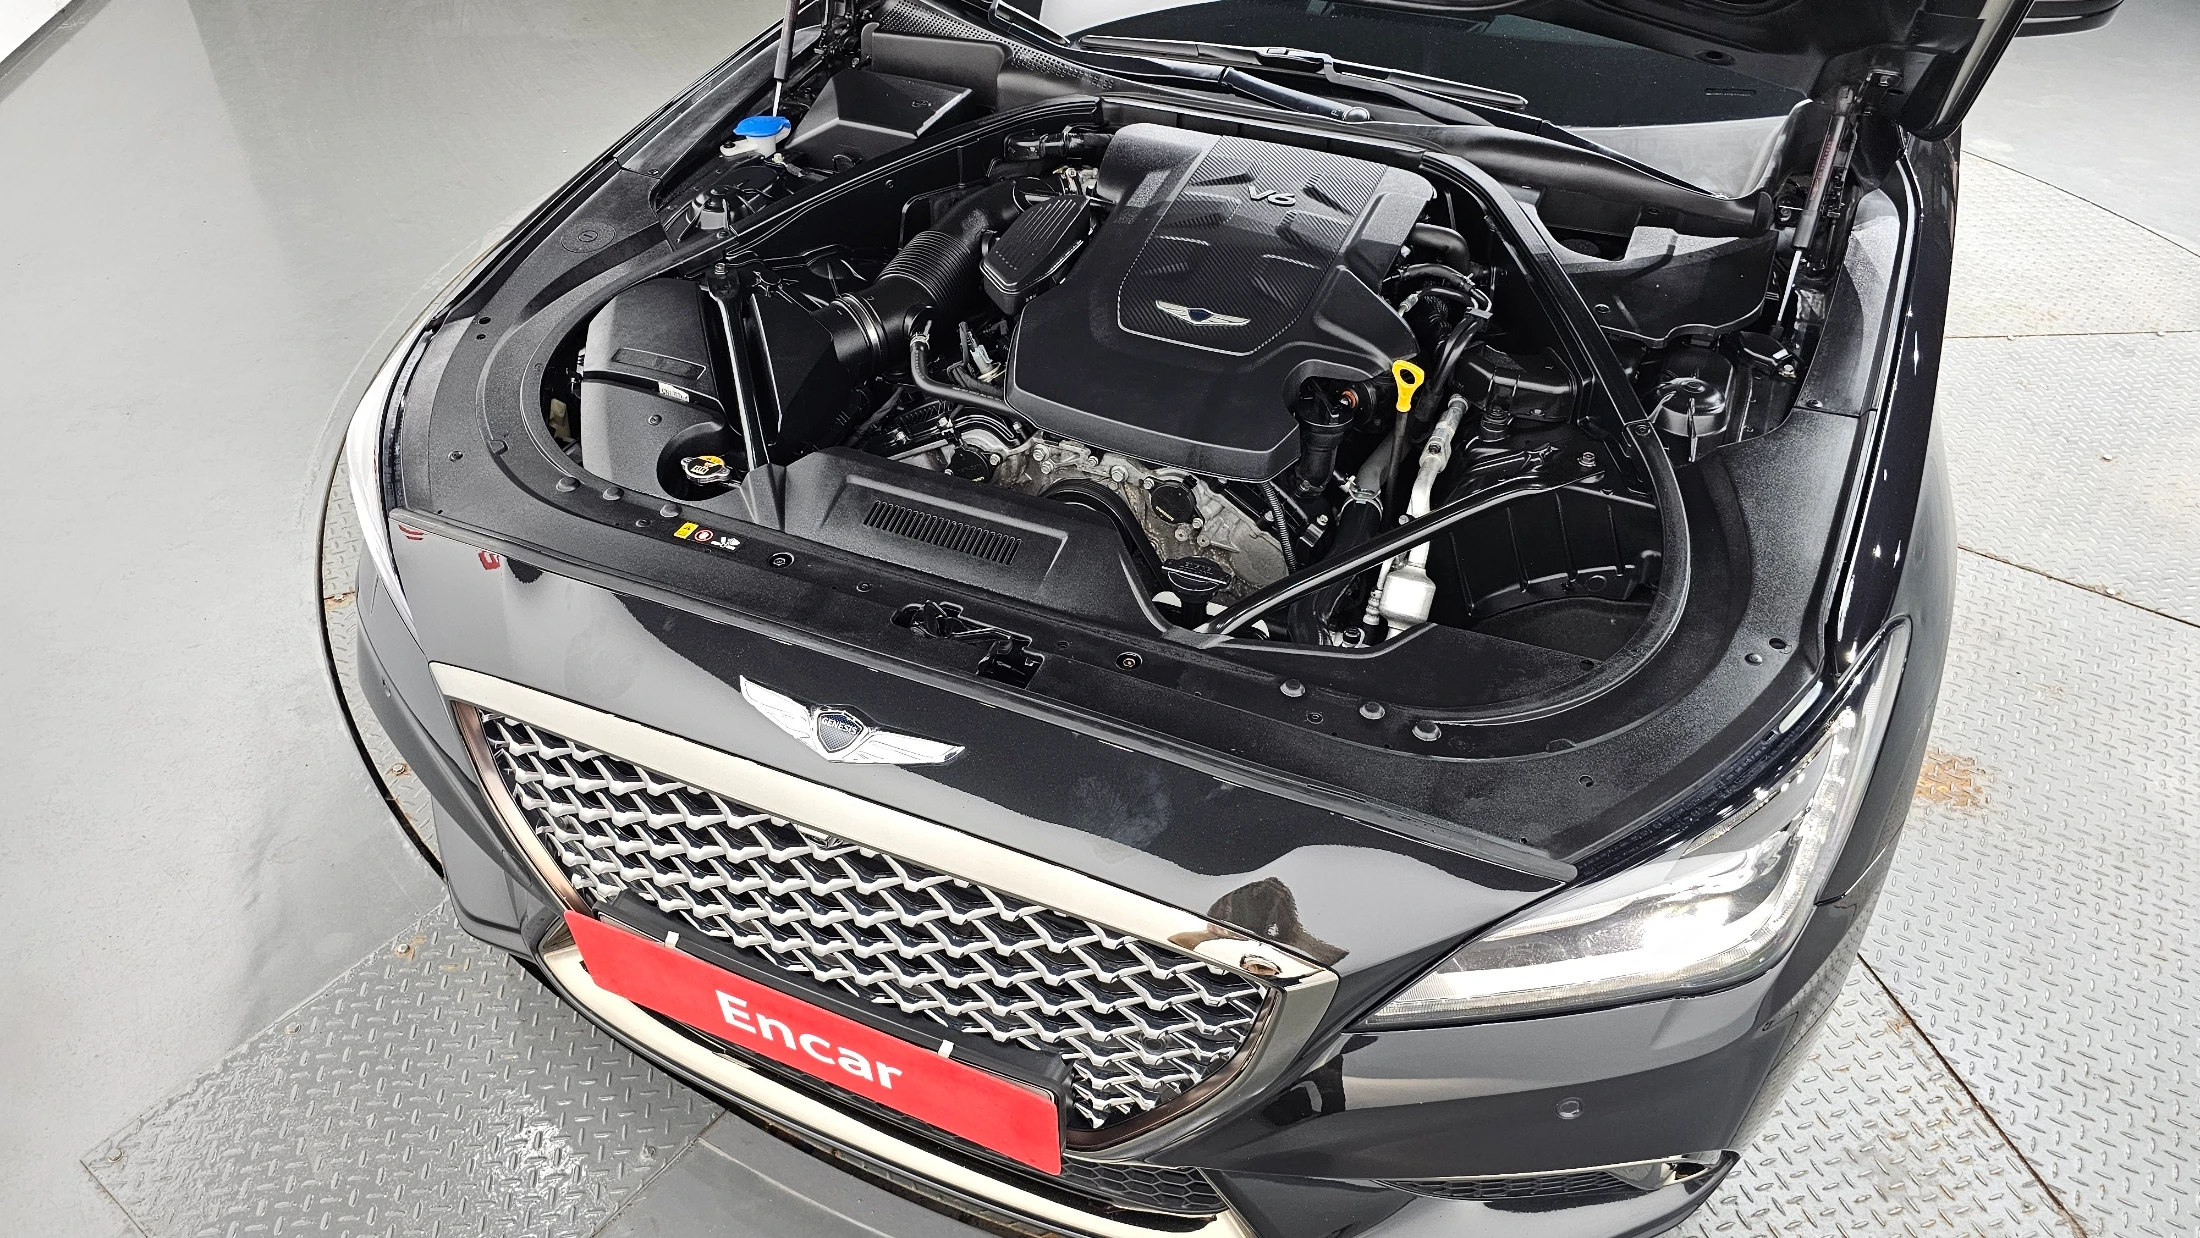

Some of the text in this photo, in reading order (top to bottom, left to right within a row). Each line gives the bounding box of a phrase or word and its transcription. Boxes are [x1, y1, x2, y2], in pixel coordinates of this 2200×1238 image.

[1249, 186, 1297, 206] V6
[821, 717, 858, 735] GENESIS
[715, 989, 903, 1090] Encar
